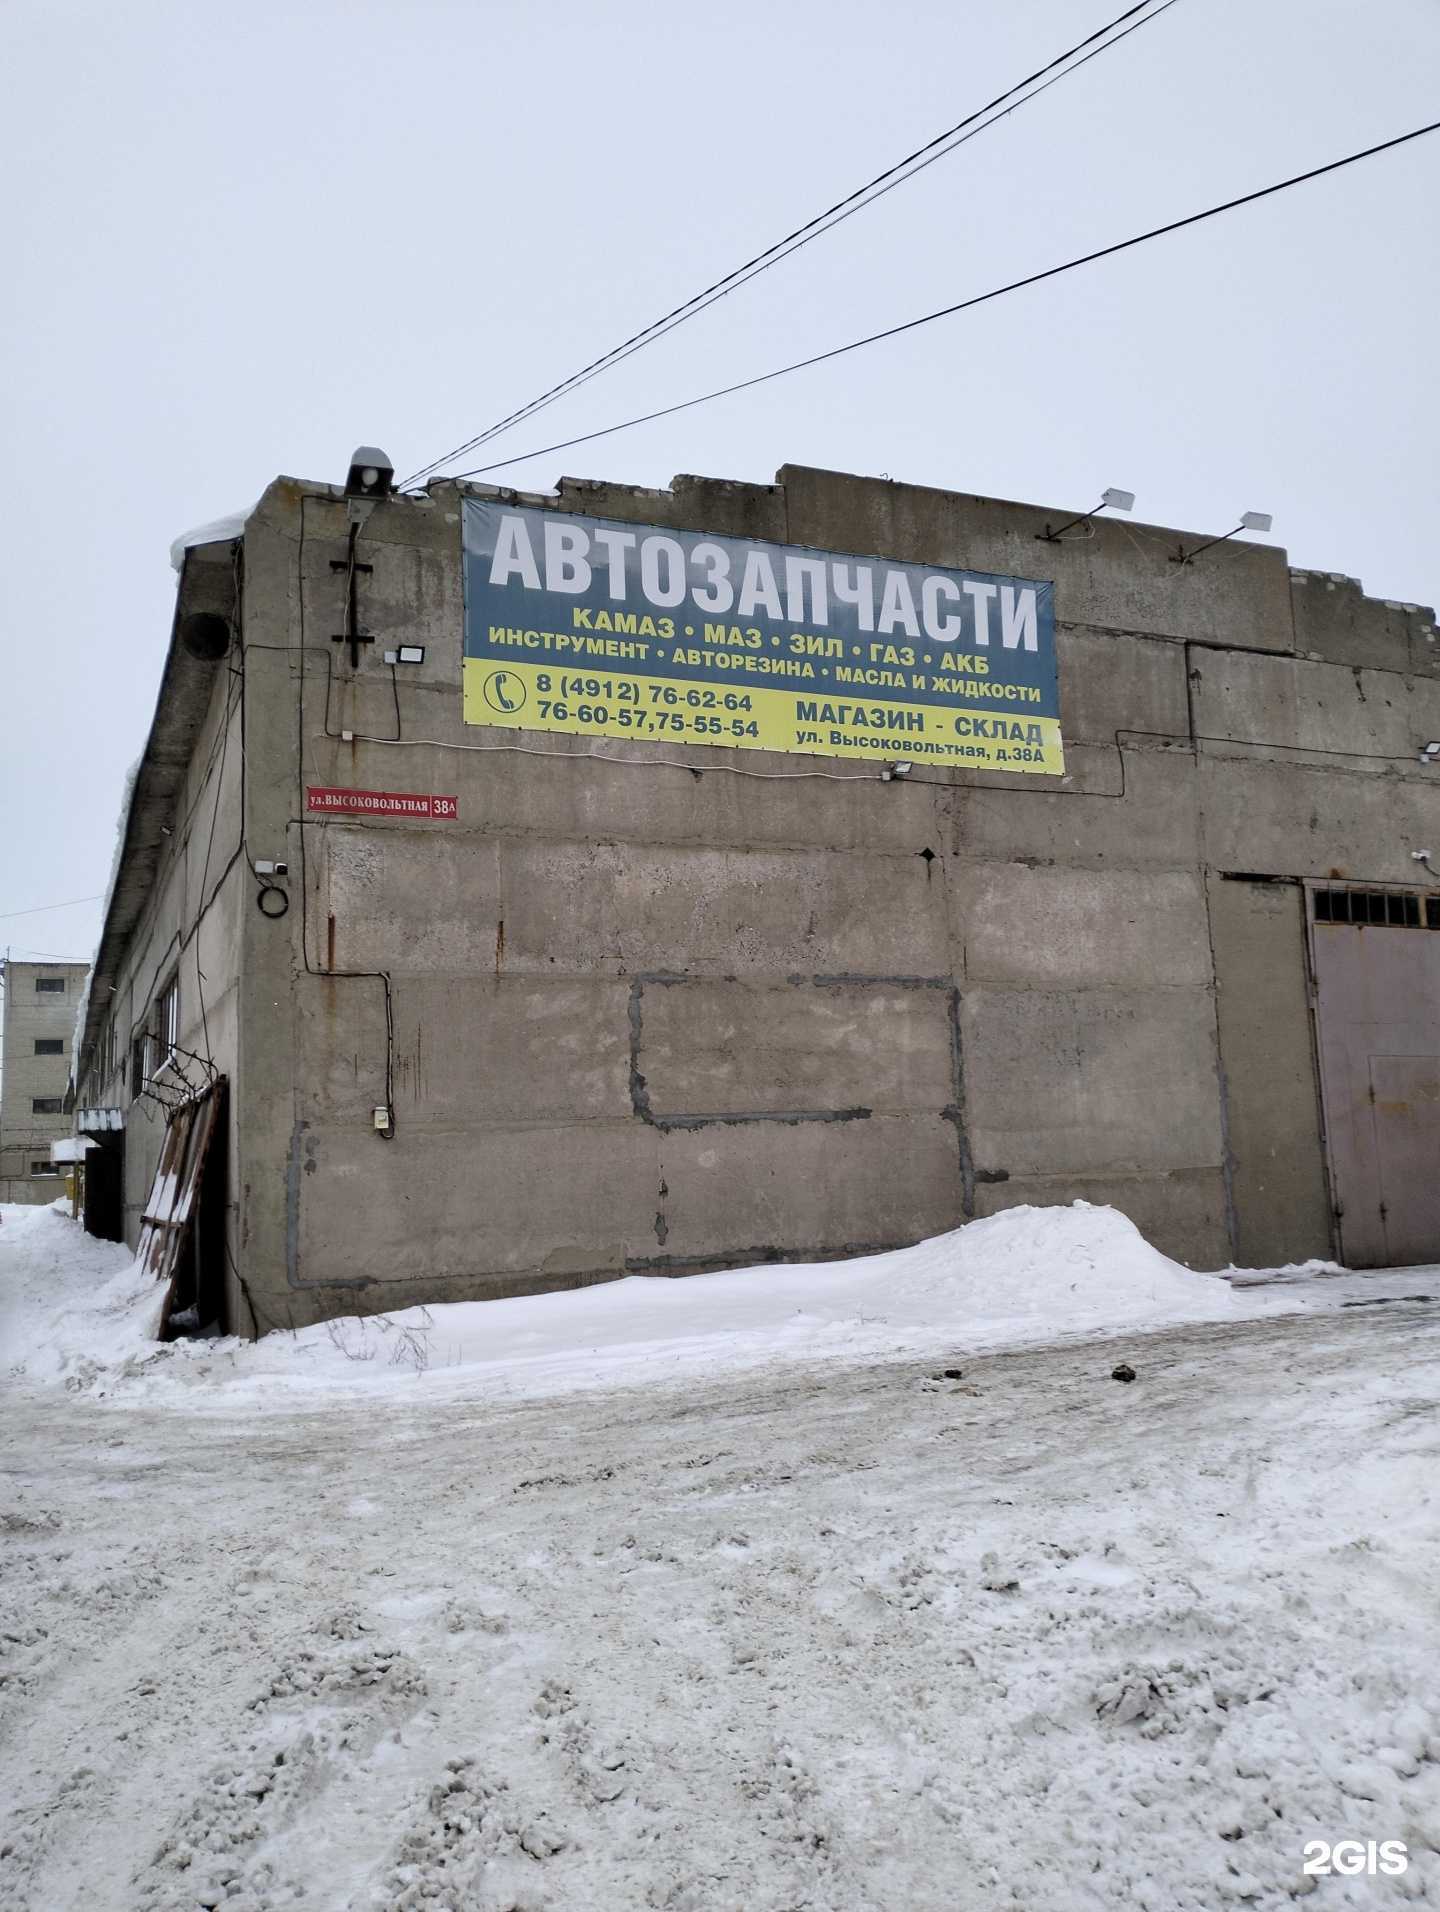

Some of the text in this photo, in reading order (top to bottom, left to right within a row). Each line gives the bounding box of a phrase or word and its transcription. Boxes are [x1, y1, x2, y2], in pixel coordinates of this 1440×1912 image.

[489, 514, 1039, 652] АВТОЗАПЧАСТИ
[489, 626, 1041, 703] ИНСТРУМЕНТ АВТОРЕЗИНА МАСЛА И ЖИДКОСТИ
[573, 607, 990, 675] КАМАЗ МАЗ ЗИЛ ГАЗ АКБ
[536, 673, 752, 711] 8 (4912) 76-62-64
[796, 701, 924, 732] МАГАЗИН
[954, 716, 1044, 748] СКЛАД
[796, 729, 1045, 763] ул. Высоковольтная, д.38А
